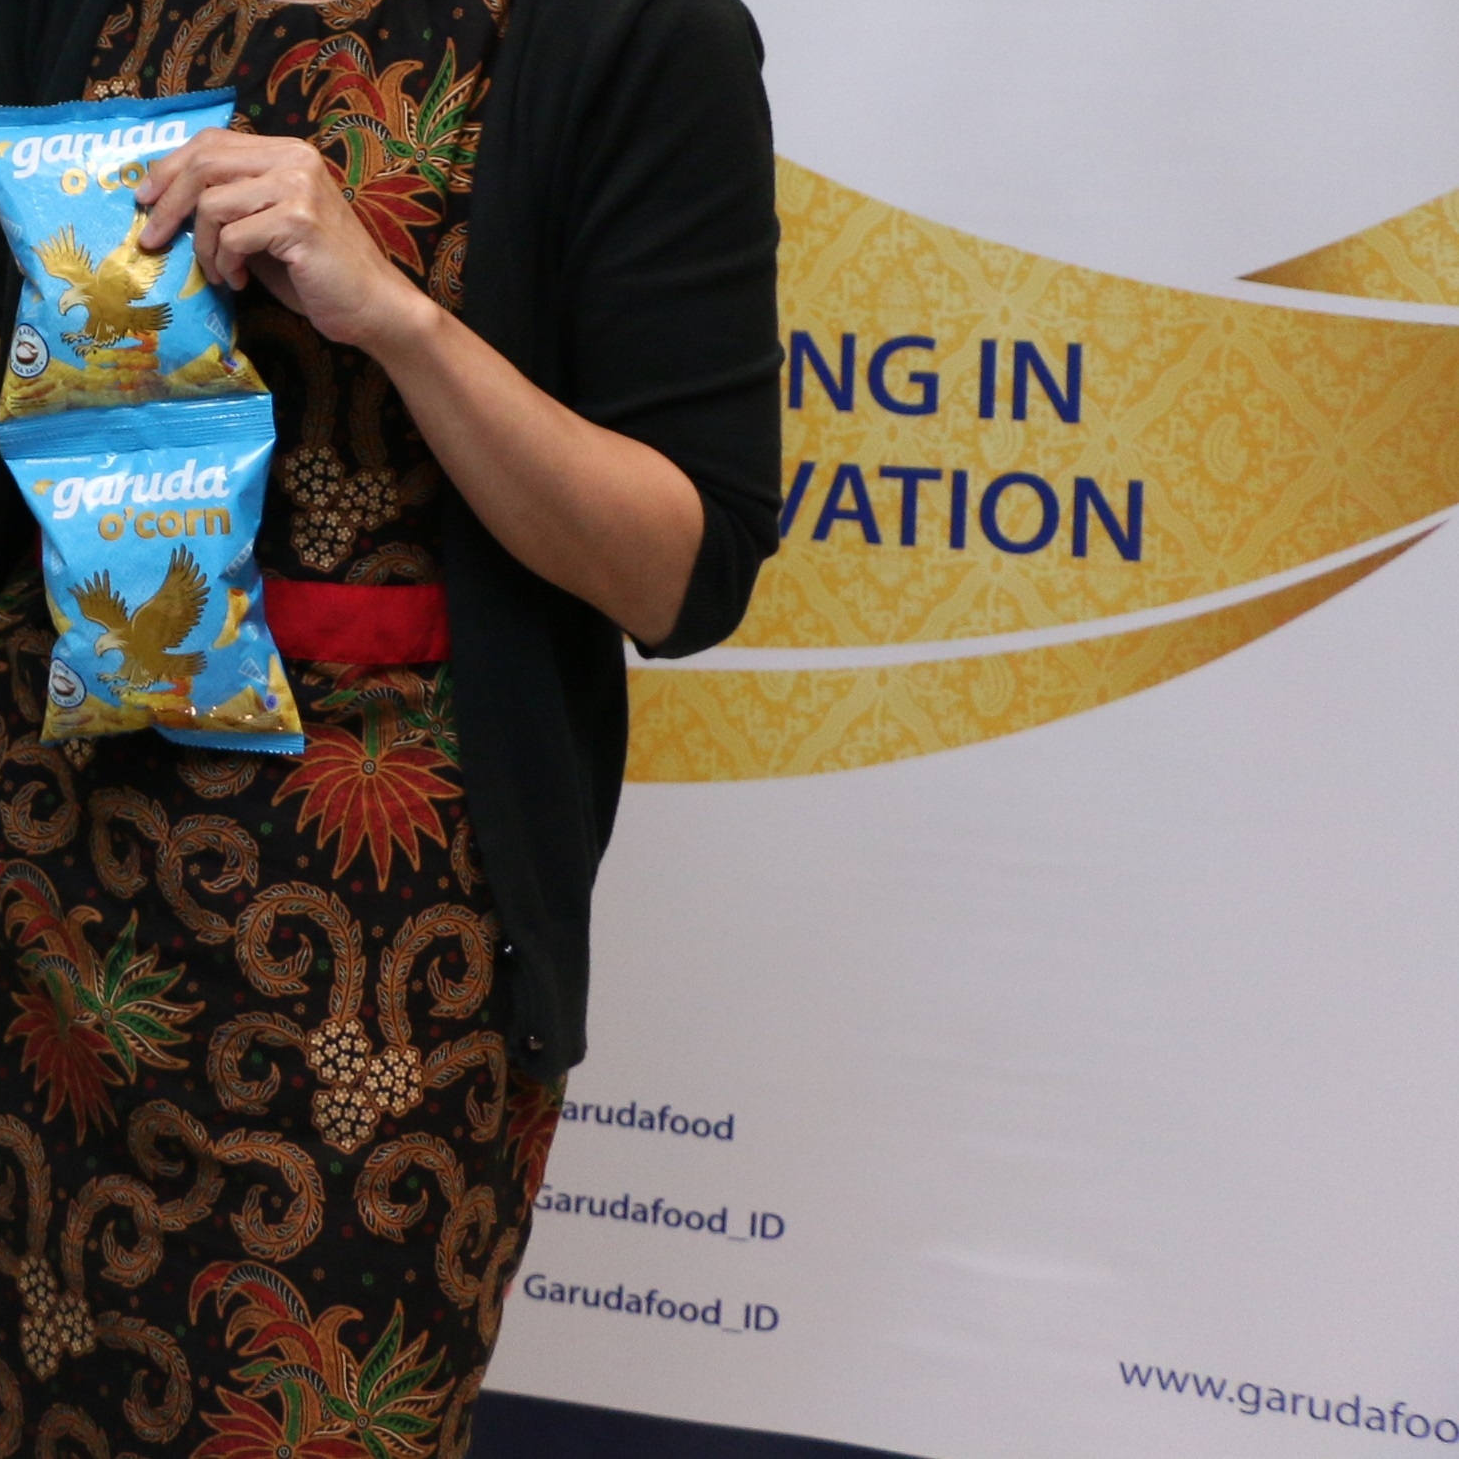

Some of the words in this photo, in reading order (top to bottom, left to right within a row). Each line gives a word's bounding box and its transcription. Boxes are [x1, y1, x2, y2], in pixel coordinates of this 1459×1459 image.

[12, 120, 193, 180] garuda
[61, 159, 162, 196] o'co
[788, 329, 941, 417] NG
[979, 338, 1083, 424] IN
[52, 458, 231, 520] garuda
[780, 460, 1144, 562] VATION
[97, 505, 231, 542] o'corn
[559, 1100, 736, 1142] arudafood
[534, 1184, 786, 1243] Garudafood_ID
[523, 1273, 781, 1334] Garudafood_ID
